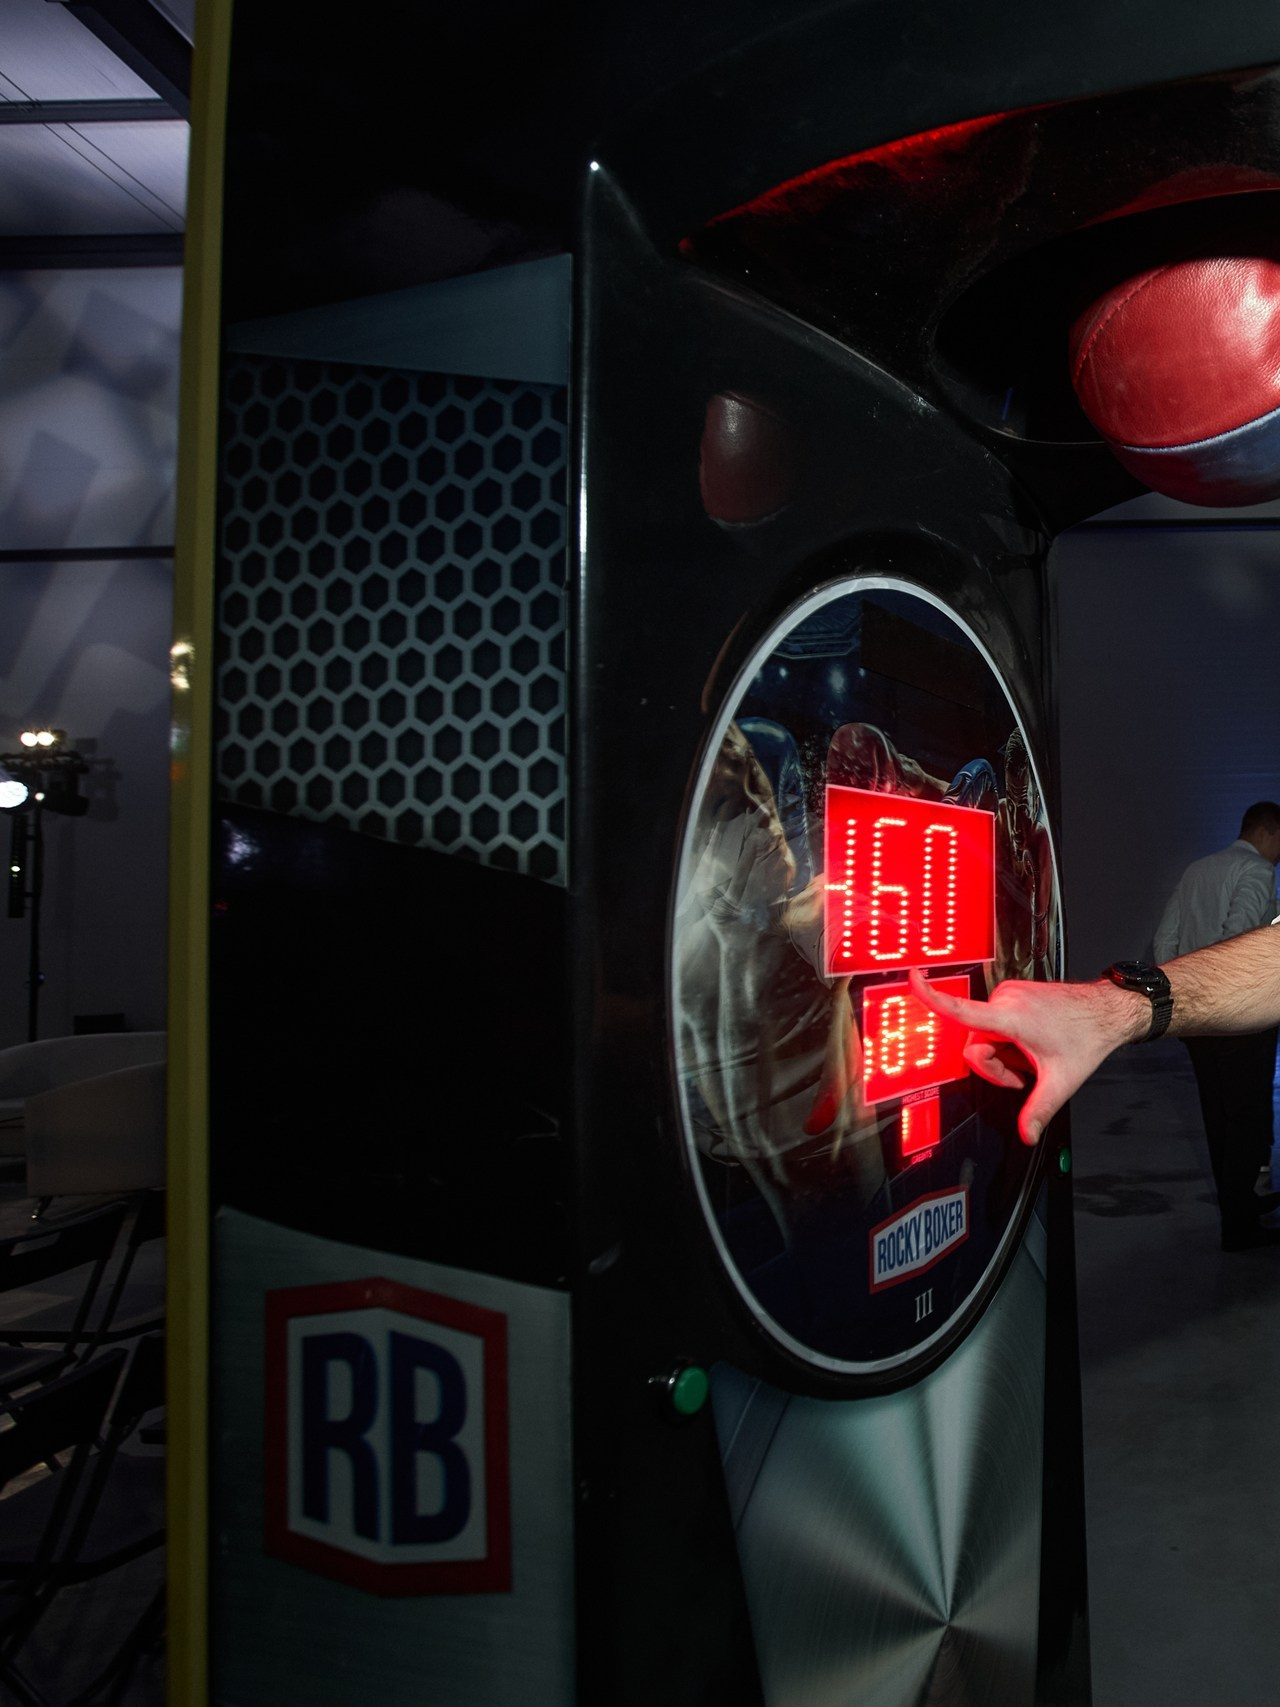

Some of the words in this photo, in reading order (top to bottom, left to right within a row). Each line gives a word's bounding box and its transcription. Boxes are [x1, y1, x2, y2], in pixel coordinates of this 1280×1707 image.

[877, 1212, 922, 1274] ROCKY
[924, 1199, 963, 1256] BOXER
[915, 1288, 934, 1323] III
[302, 1329, 472, 1546] RB
